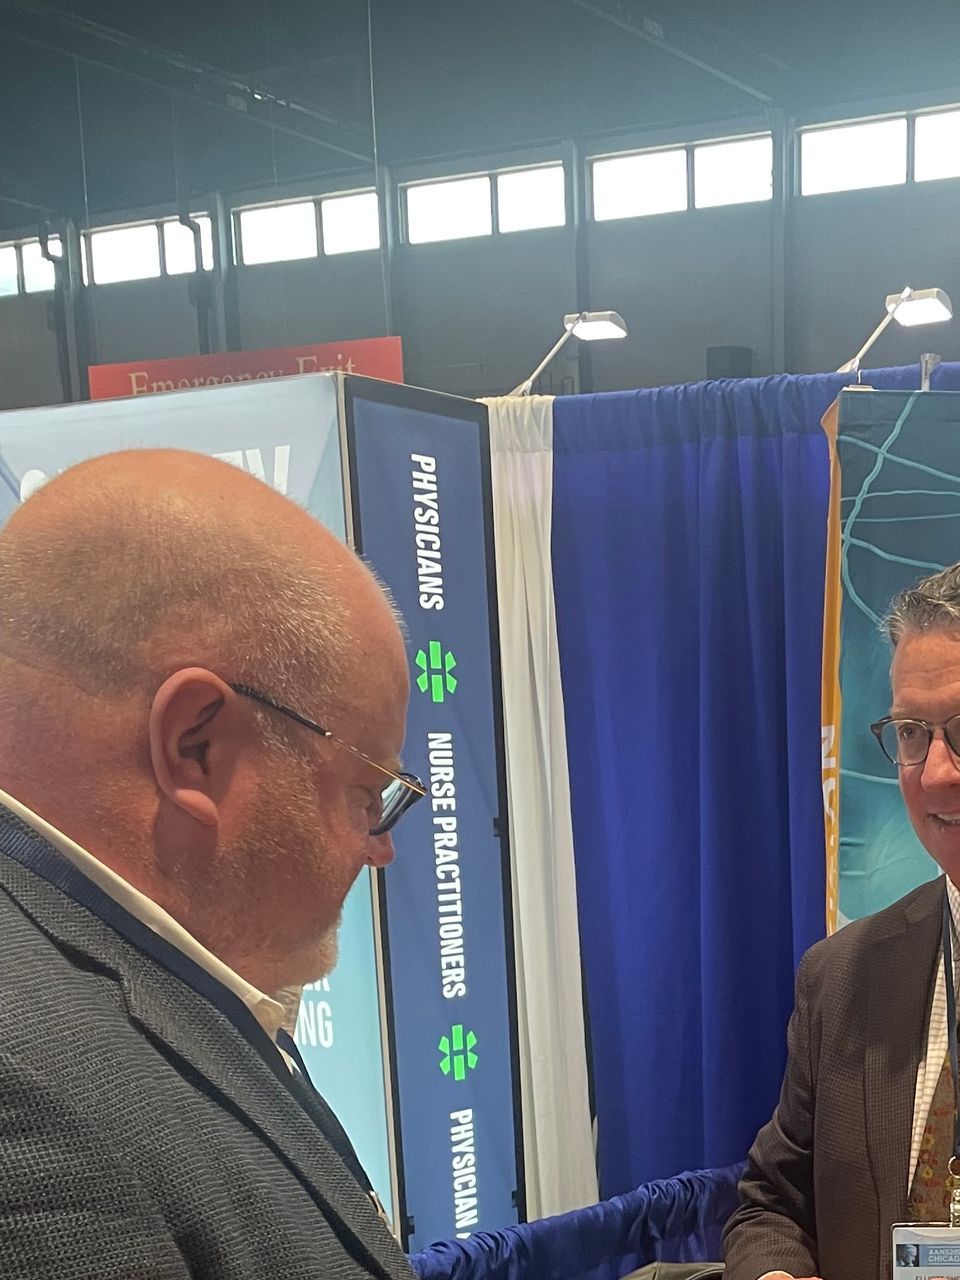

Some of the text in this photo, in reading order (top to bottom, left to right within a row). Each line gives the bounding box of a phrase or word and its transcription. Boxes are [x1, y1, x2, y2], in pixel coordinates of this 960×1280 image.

[410, 452, 444, 611] PHYSICIANS
[427, 731, 467, 999] NURSE PRACTITIONERS
[449, 1107, 479, 1226] PHYSICIAN
